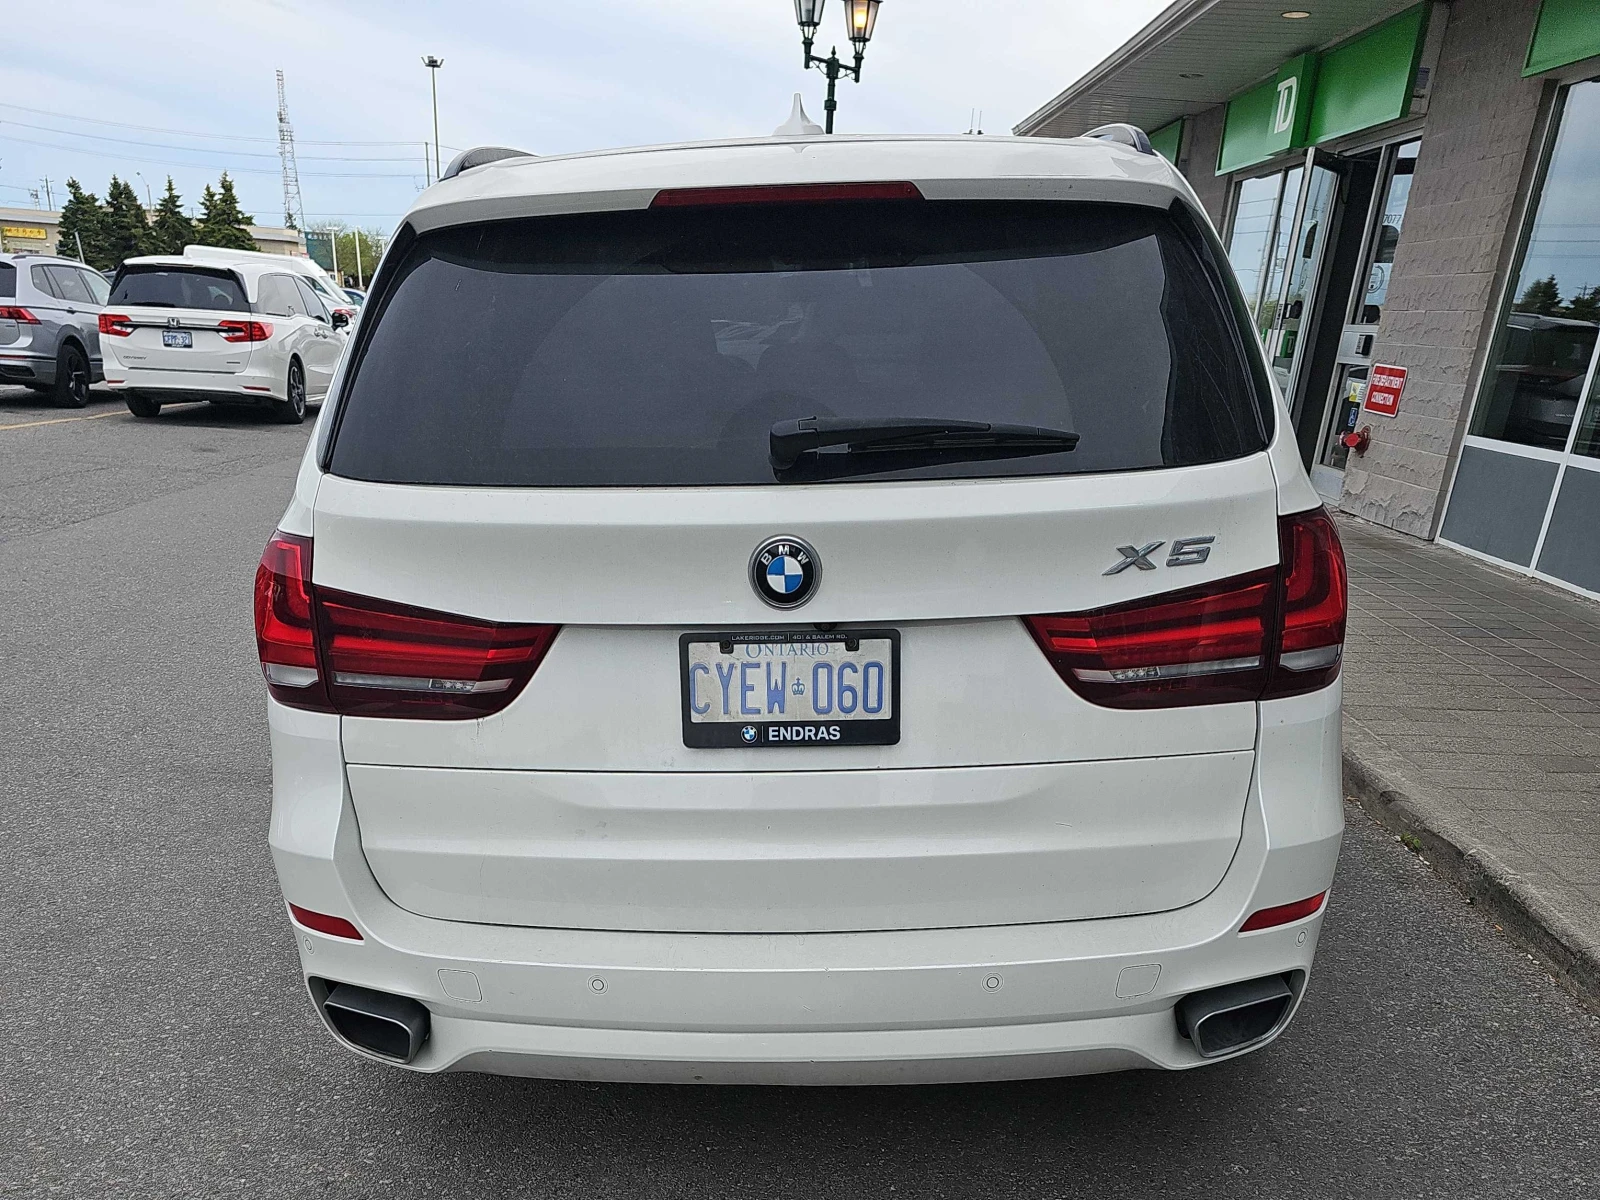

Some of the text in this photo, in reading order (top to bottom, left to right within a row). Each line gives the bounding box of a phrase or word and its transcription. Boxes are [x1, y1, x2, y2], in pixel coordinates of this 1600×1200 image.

[1274, 76, 1297, 134] TD
[1383, 214, 1402, 224] 7077
[761, 545, 809, 565] BMW
[1102, 536, 1215, 576] X5
[745, 643, 829, 658] ONTARIO
[689, 660, 884, 715] CYEW 060
[768, 726, 841, 741] ENDRAS
